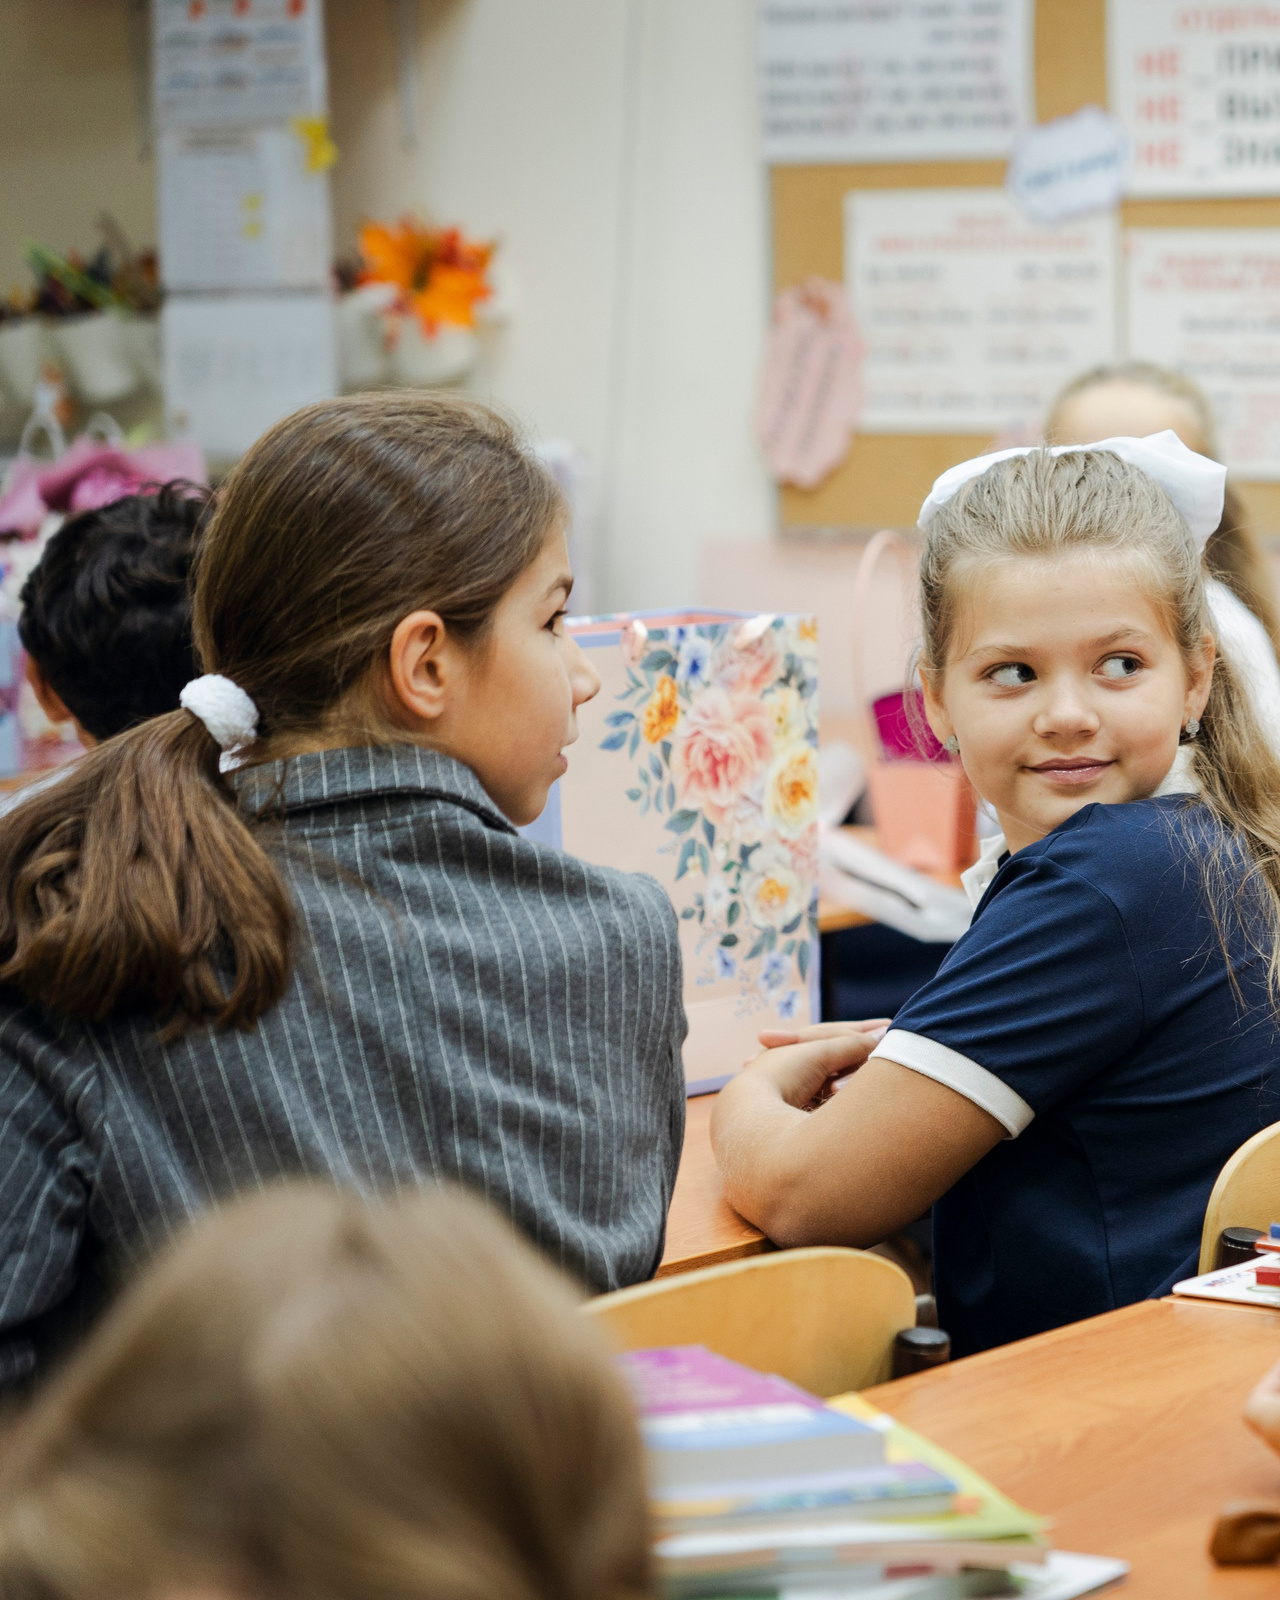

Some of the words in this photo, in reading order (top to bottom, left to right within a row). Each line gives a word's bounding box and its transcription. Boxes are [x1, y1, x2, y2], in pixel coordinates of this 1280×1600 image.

[1136, 47, 1179, 76] НЕ
[1136, 95, 1179, 122] НЕ
[1136, 141, 1179, 167] НЕ
